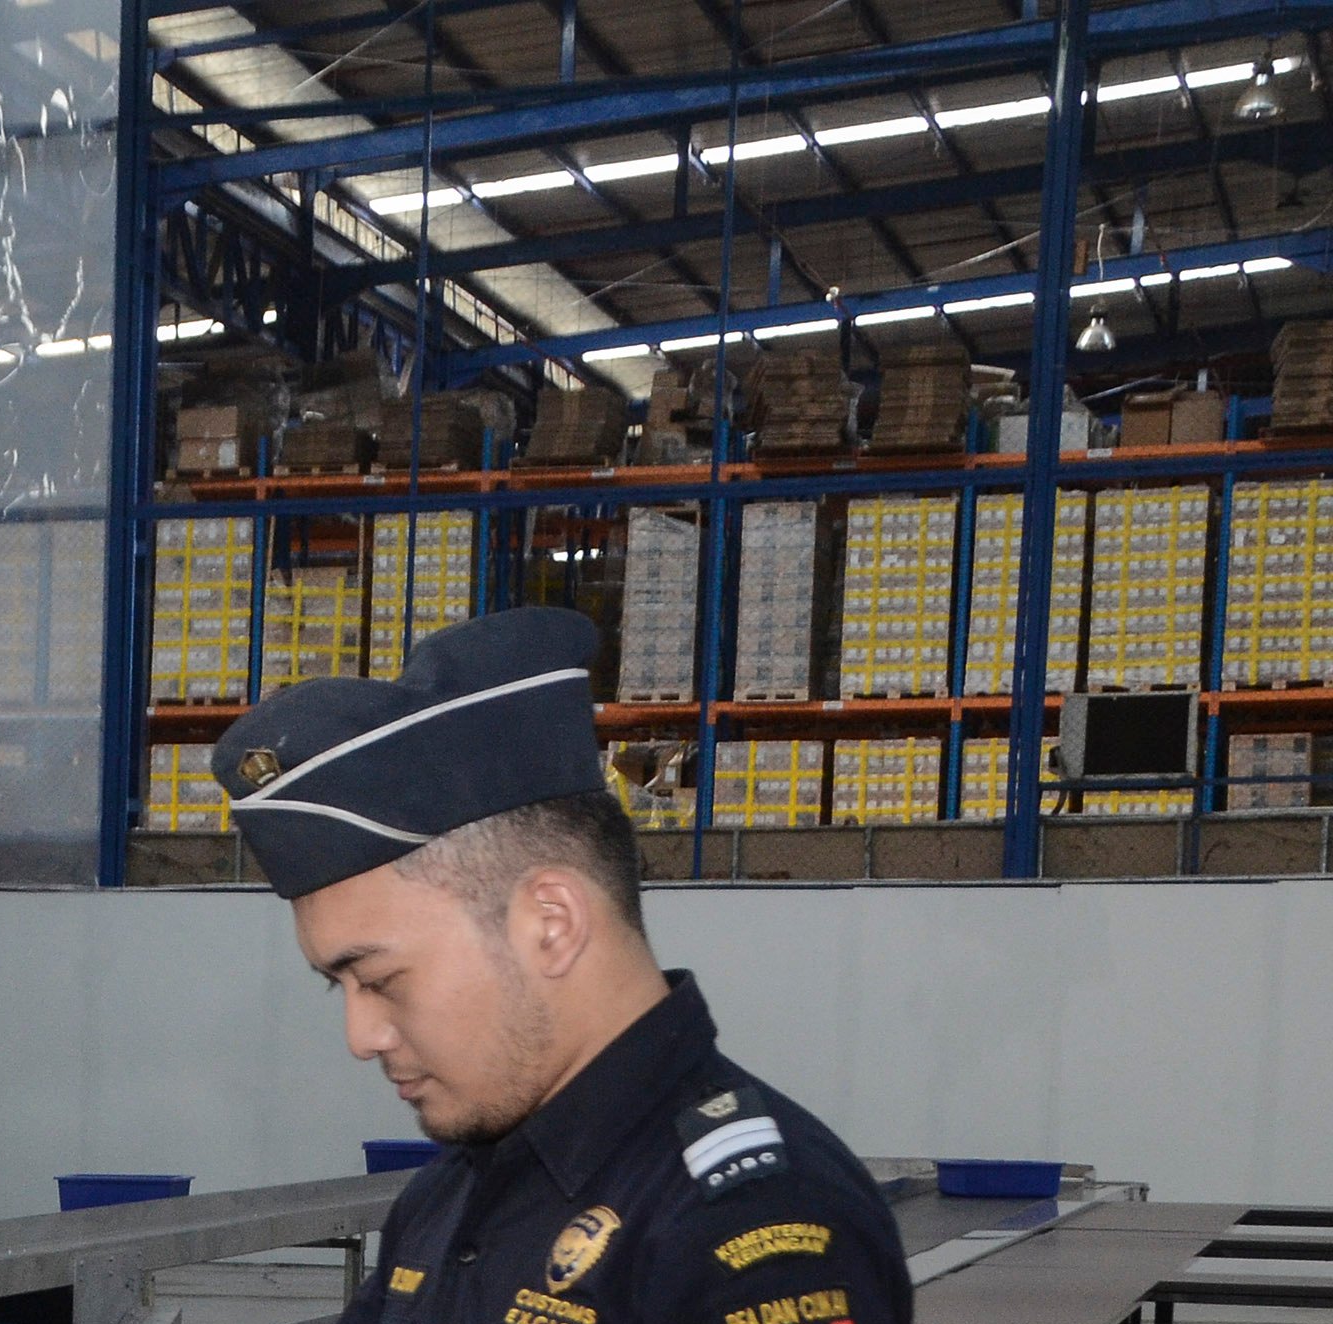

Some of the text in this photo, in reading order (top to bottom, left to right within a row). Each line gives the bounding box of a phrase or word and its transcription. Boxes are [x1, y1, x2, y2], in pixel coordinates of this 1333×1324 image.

[708, 1152, 777, 1187] DJBC
[714, 1223, 831, 1262] KEMENTERIAN
[729, 1237, 824, 1269] KEUANGAN
